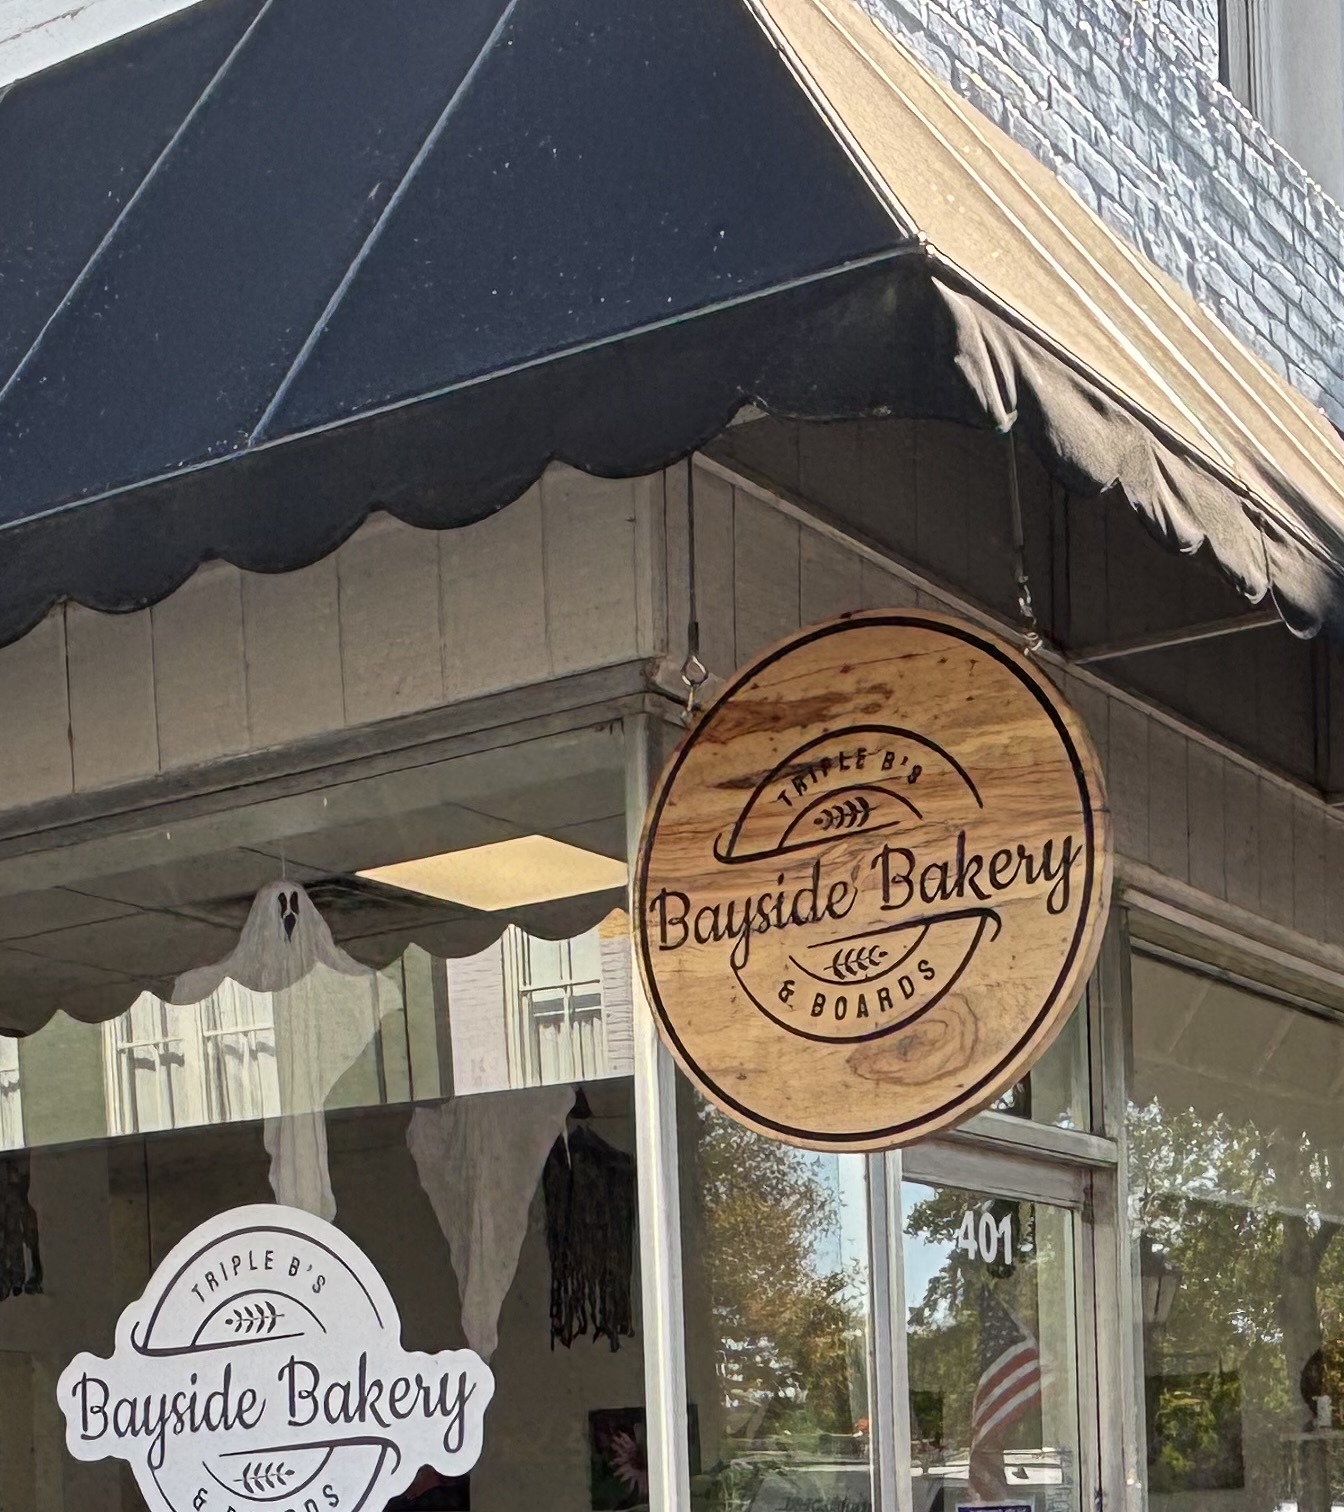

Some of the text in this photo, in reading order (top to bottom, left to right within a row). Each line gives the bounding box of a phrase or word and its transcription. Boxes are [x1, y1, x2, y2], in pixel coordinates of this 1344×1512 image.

[777, 747, 923, 807] TRIPLE B'S
[649, 830, 1083, 969] Bayside Bakery
[777, 958, 937, 1021] & BOARDS
[956, 1210, 1012, 1265] 401
[191, 1249, 327, 1303] TRIPLE B'S
[71, 1351, 477, 1470] Bayside Bakery
[192, 1487, 209, 1512] &
